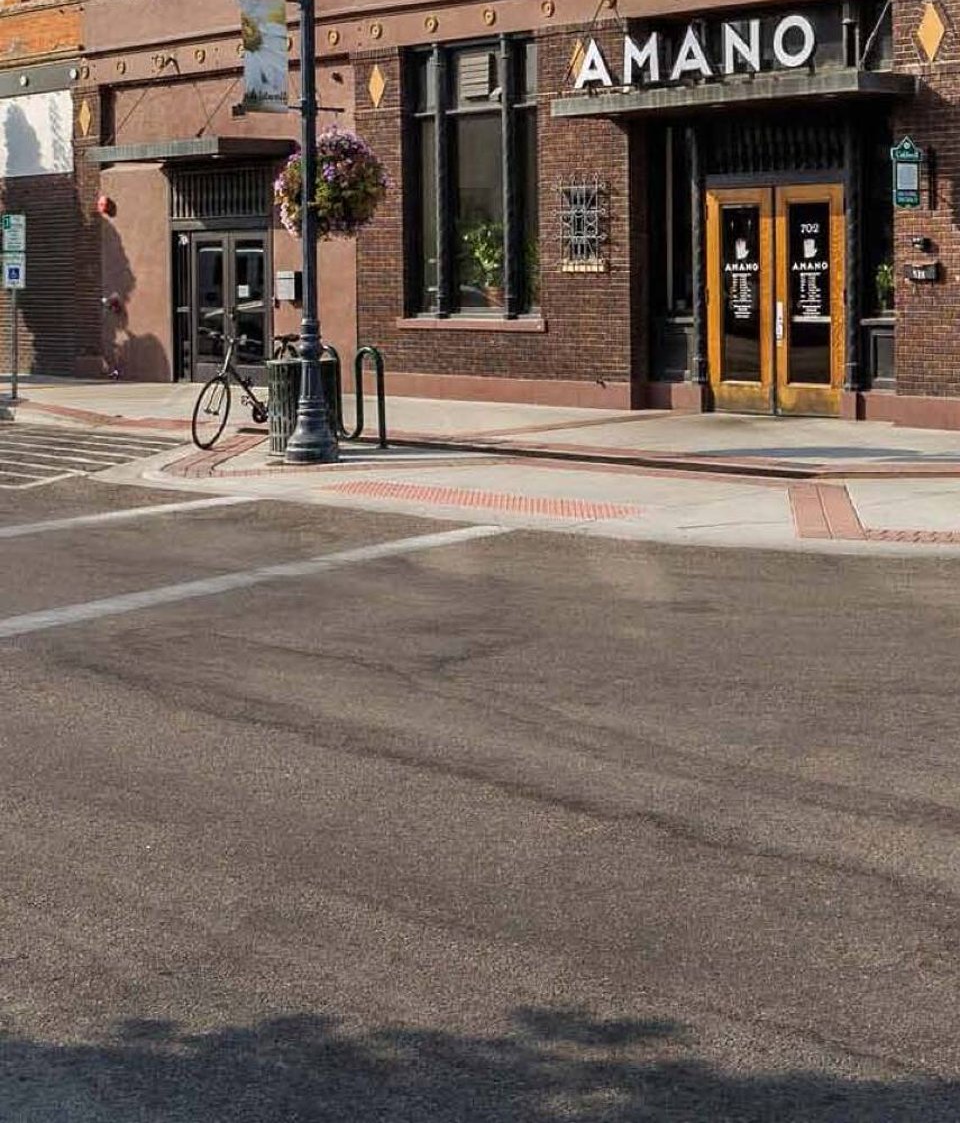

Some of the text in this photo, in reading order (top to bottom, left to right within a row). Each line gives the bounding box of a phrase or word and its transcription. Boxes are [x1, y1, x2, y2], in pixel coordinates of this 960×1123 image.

[574, 15, 815, 89] AMANO
[801, 223, 819, 233] 702
[724, 263, 759, 272] AMANO
[792, 261, 828, 271] AMANO
